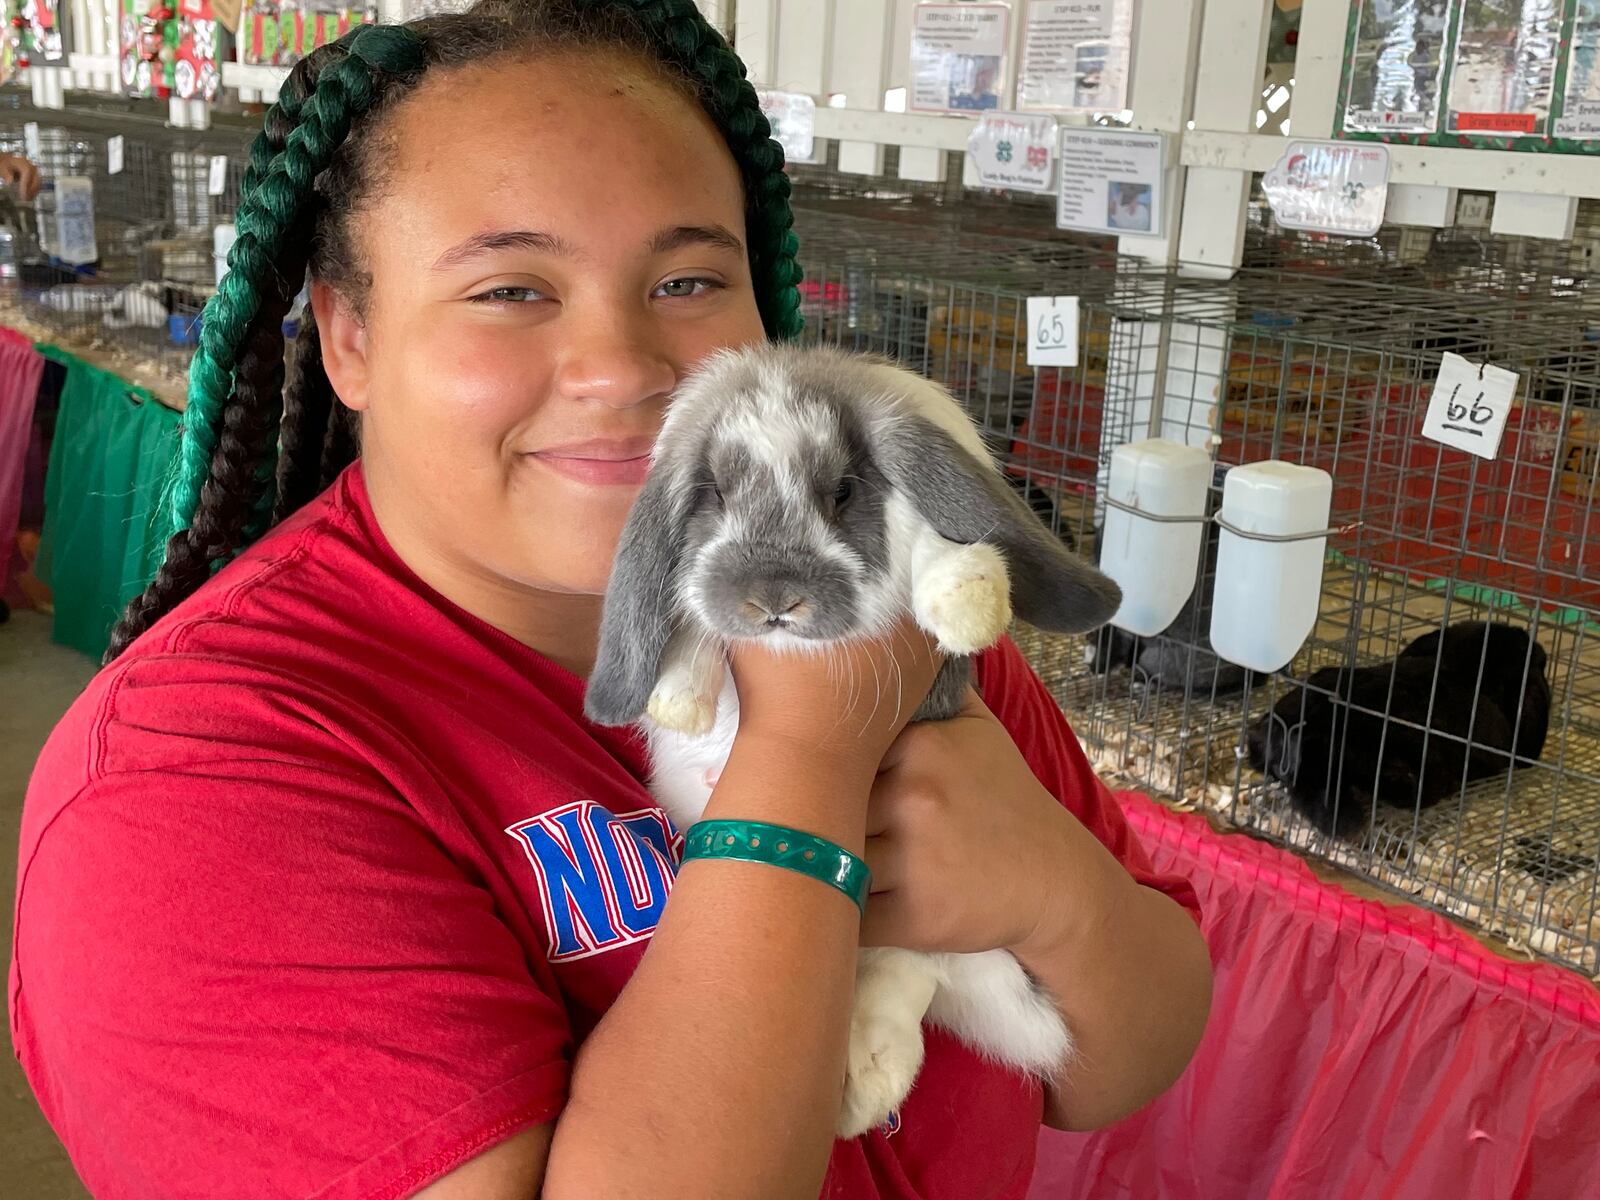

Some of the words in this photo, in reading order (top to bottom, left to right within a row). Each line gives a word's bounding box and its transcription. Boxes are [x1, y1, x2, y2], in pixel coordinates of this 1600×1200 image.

[1036, 313, 1066, 345] 65
[1446, 383, 1494, 425] 66
[504, 799, 684, 964] NO
